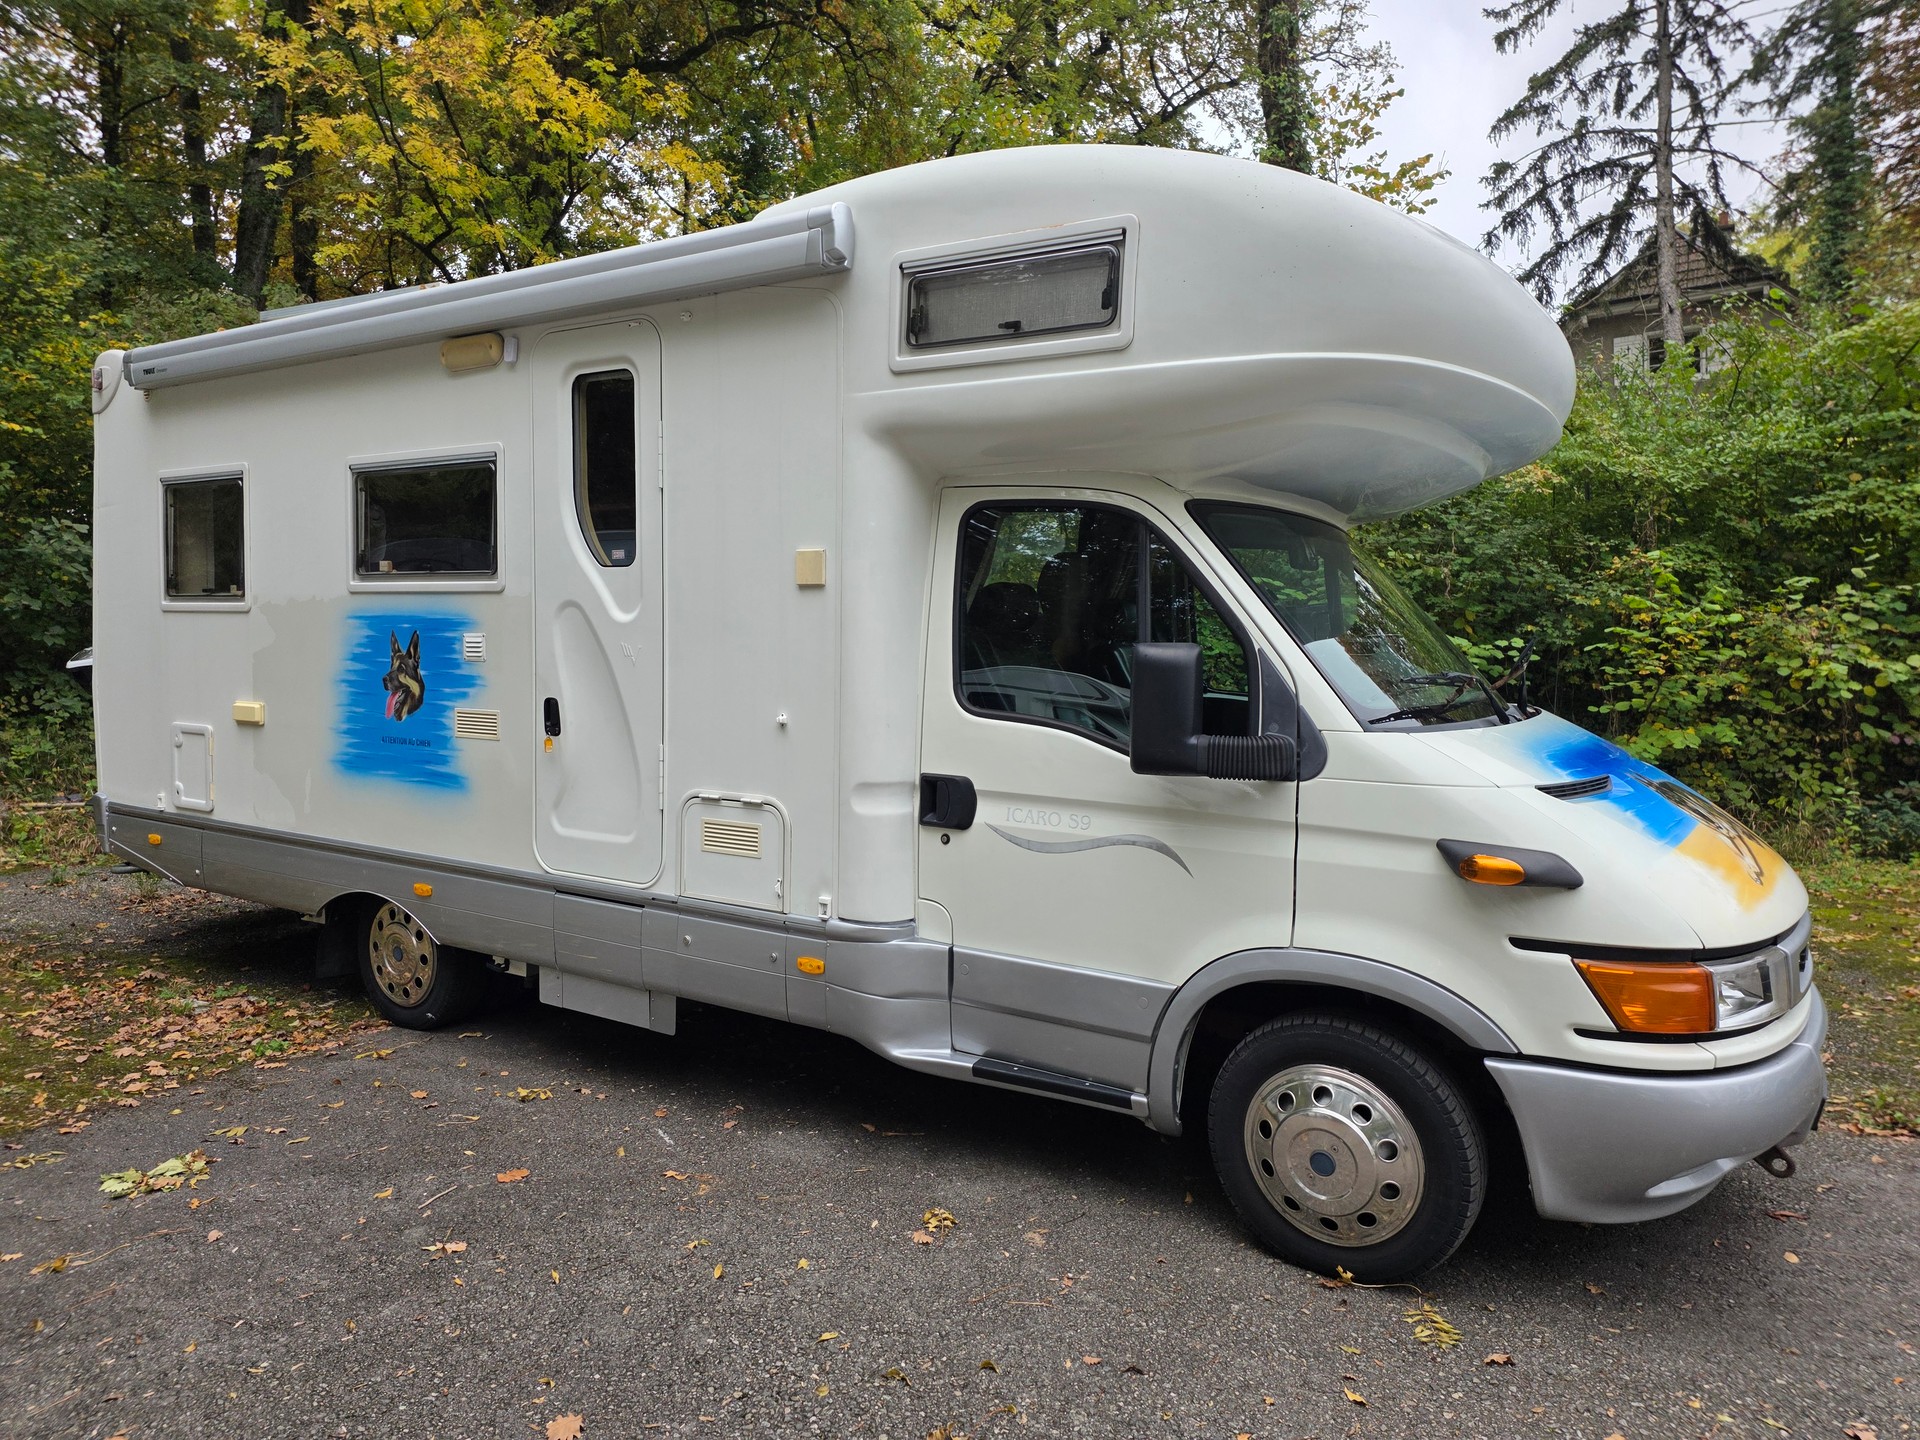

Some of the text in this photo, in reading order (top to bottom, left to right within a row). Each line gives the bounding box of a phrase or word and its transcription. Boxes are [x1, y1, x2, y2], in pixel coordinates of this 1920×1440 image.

[381, 736, 407, 745] ATTENTION
[416, 739, 431, 747] CHIEN
[1006, 807, 1092, 830] ICARO S9
